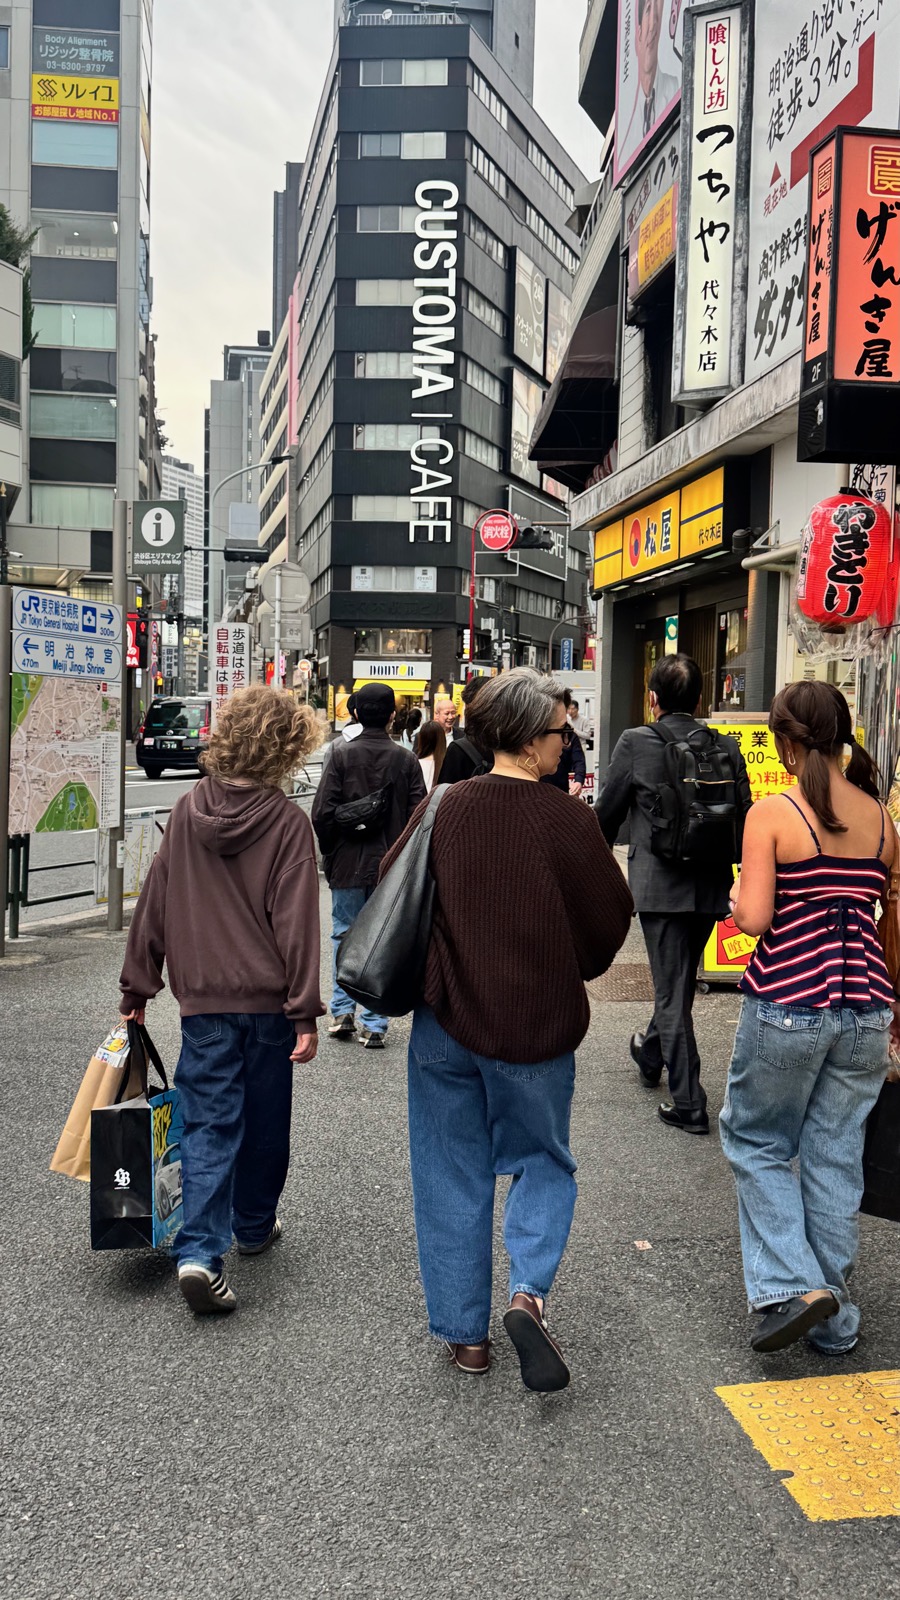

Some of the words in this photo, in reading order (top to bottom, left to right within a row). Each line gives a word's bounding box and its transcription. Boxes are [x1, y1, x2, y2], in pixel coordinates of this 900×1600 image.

[45, 34, 65, 45] Body
[67, 36, 107, 47] Alignment
[40, 45, 114, 62] リジック整骨院
[46, 60, 106, 73] 03-6300-9797
[707, 23, 727, 110] 喰しん坊
[62, 82, 115, 103] ソレイユ
[34, 106, 116, 121] お部屋探し地域No.1
[694, 124, 735, 263] つちや
[763, 178, 788, 218] 現在地
[411, 180, 459, 399] CUSTOMA
[855, 201, 900, 378] げんき屋
[697, 280, 720, 372] 代々木店
[811, 361, 822, 384] 2F
[409, 438, 454, 543] CAFE
[484, 525, 510, 539] 消火栓
[644, 508, 672, 559] 松屋
[698, 522, 722, 545] 代々木店
[824, 502, 876, 617] やきとり
[21, 595, 40, 613] JR
[41, 598, 79, 619] 東京総合病院
[21, 613, 27, 624] JR
[28, 614, 42, 628] Tokyo
[44, 616, 61, 630] General
[62, 620, 79, 632] Hospital
[100, 627, 115, 637] 300m
[22, 658, 39, 668] 470m
[44, 640, 113, 664] 明治神宮
[53, 659, 67, 674] Meiji
[69, 662, 85, 674] Jingu
[87, 663, 105, 675] Shrine
[370, 664, 414, 676] DOUTOR
